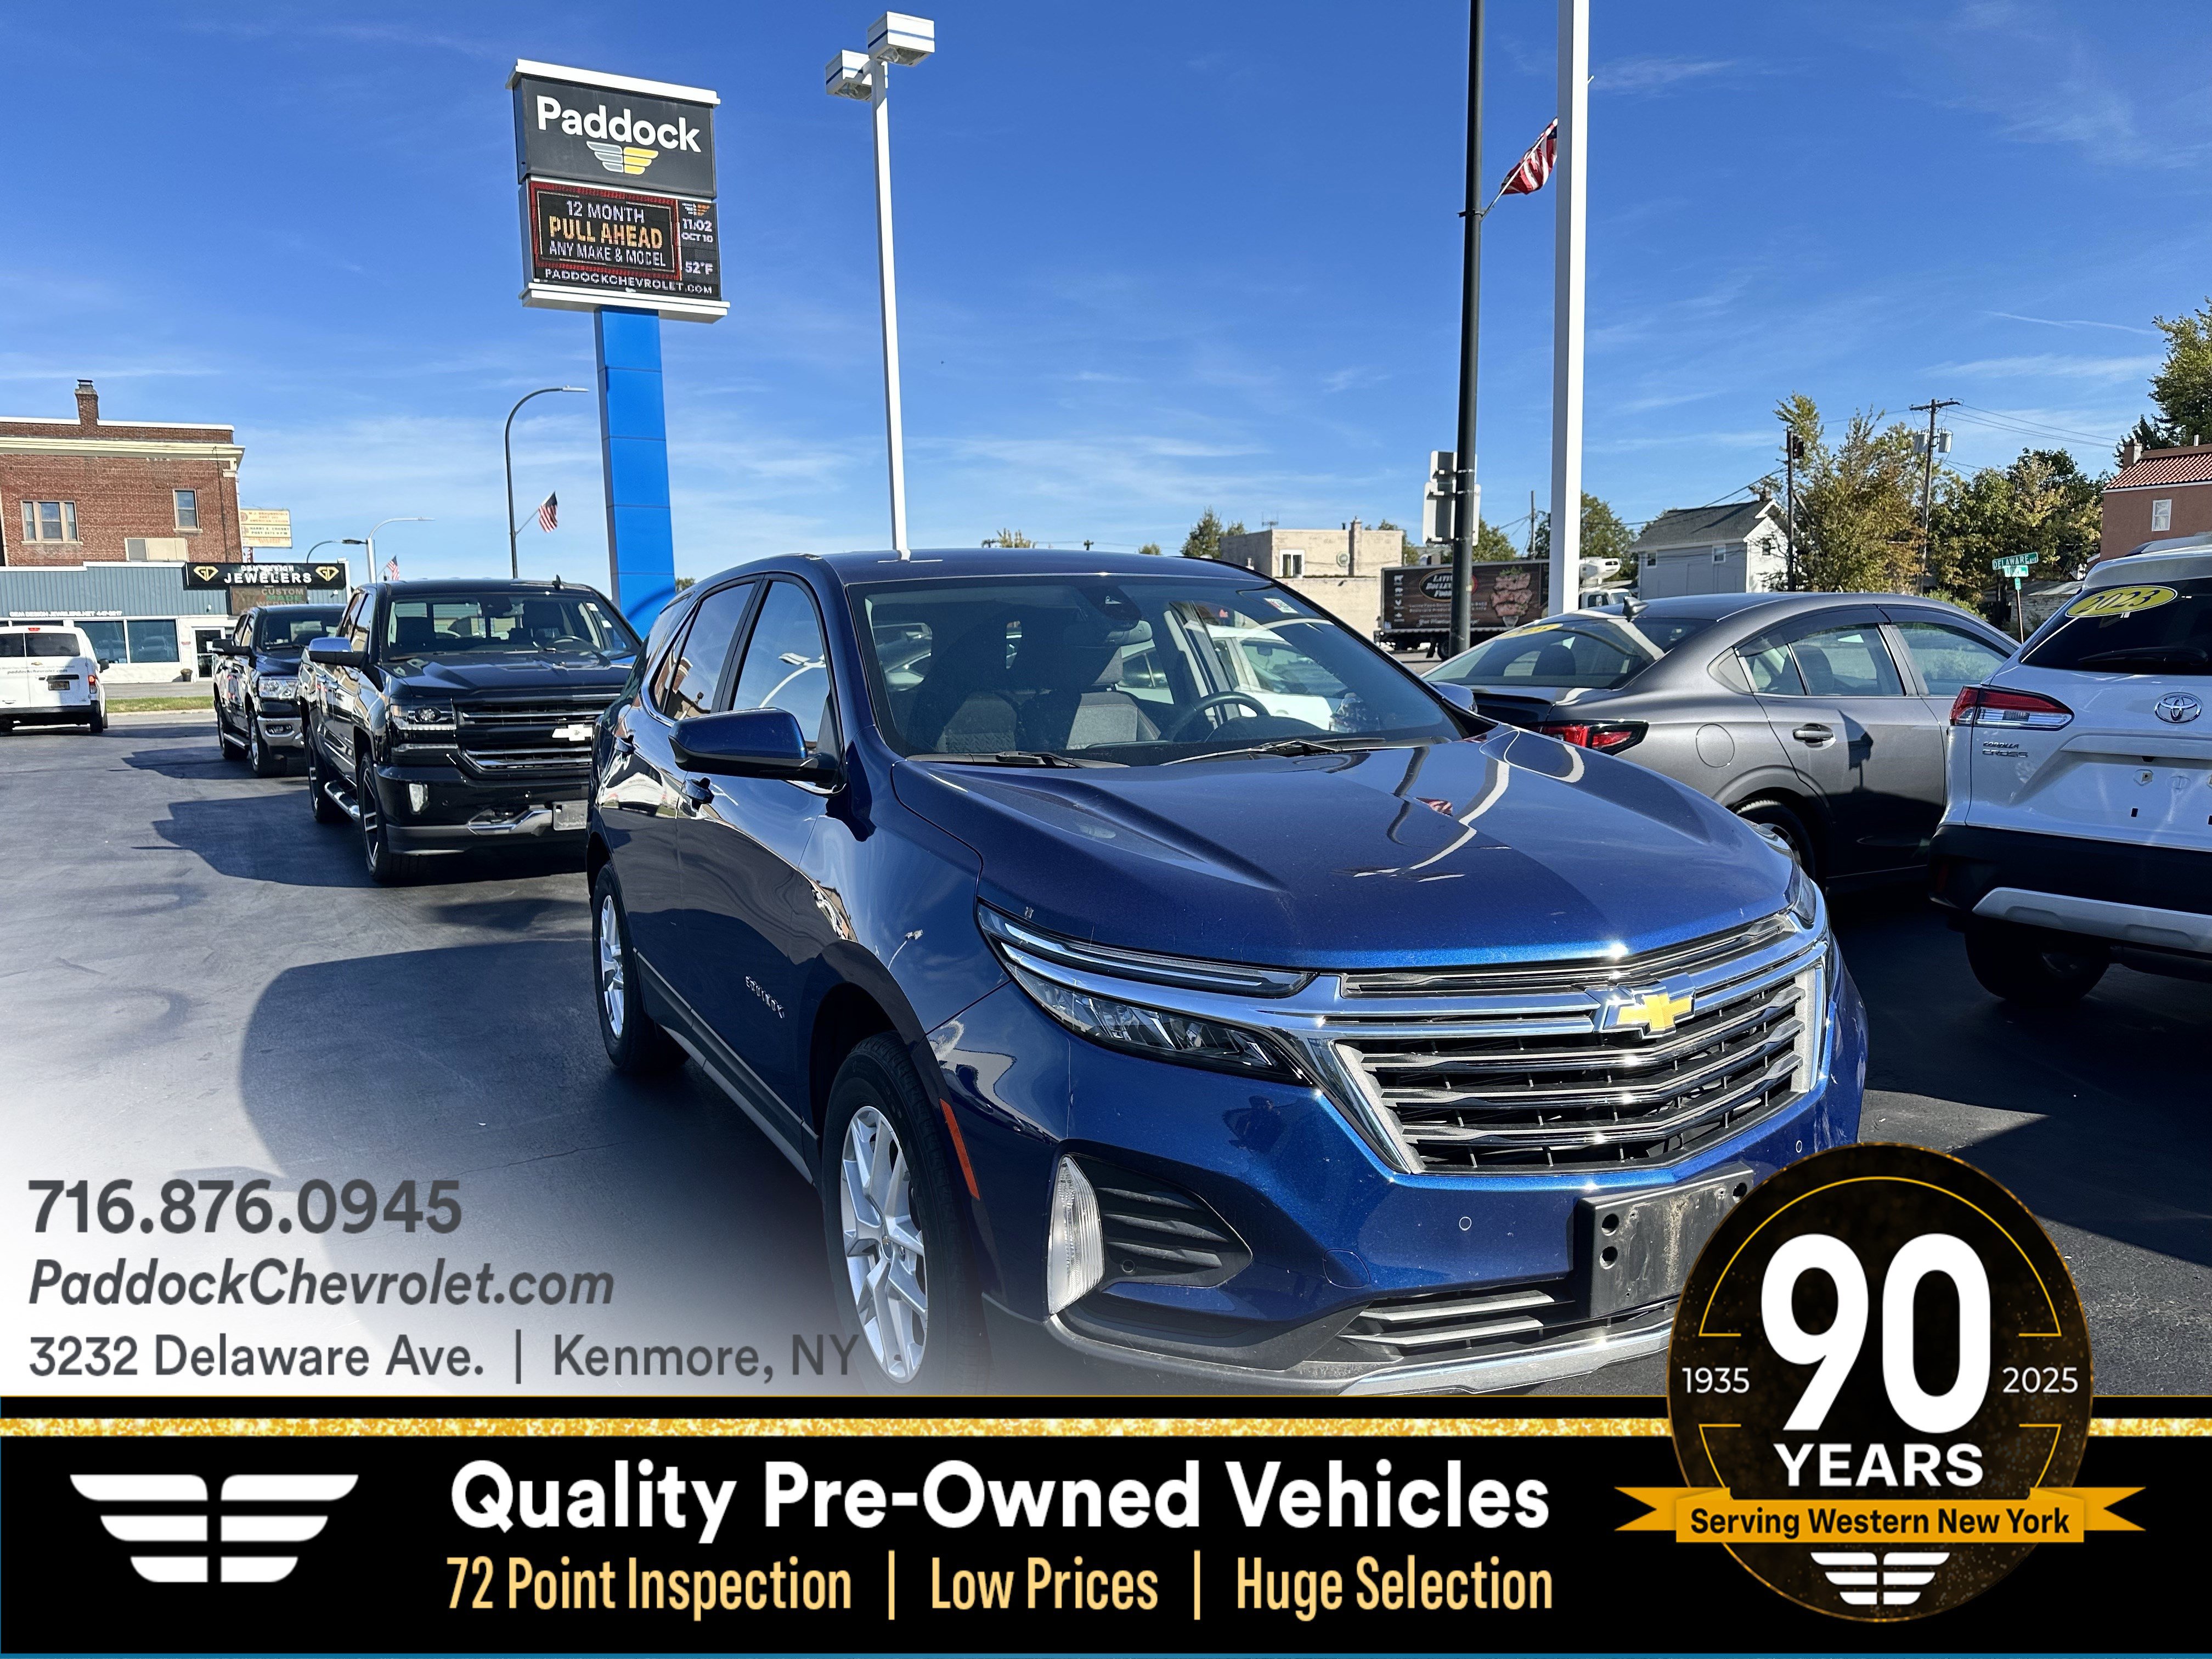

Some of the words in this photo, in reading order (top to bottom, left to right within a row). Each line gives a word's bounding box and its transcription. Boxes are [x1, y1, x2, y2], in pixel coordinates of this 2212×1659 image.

[537, 95, 701, 153] Paddock
[567, 200, 583, 217] 12
[588, 202, 645, 223] MONTH
[549, 215, 595, 242] PULL
[601, 222, 663, 249] AHEAD
[681, 232, 701, 241] OCT
[702, 234, 713, 243] 10
[549, 240, 574, 257] ANY
[576, 242, 612, 262] MAKE
[615, 247, 623, 263] &
[545, 268, 713, 295] PADDOCKCHEVROLET.COM
[1993, 555, 2029, 568] DELAWARE
[223, 572, 312, 584] JEWELERS
[2076, 589, 2161, 613] 2023
[1982, 749, 2029, 758] CROSS
